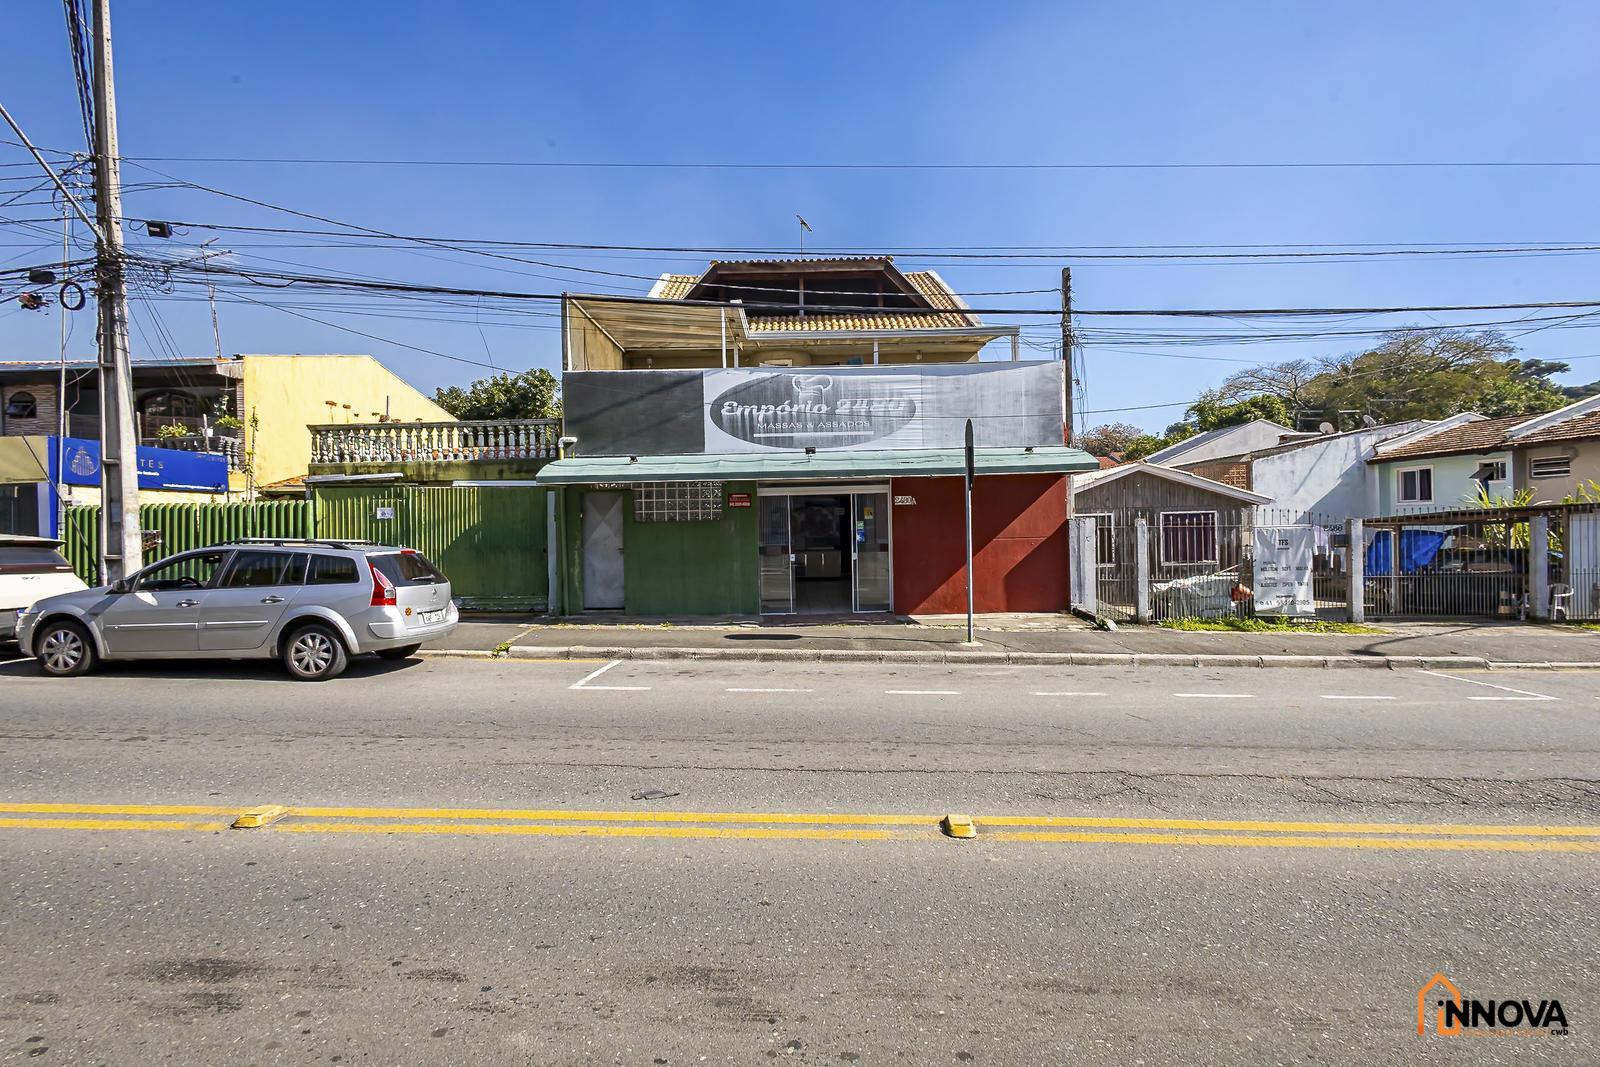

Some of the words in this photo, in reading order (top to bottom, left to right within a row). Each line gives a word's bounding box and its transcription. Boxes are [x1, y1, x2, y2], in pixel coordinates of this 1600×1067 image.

[721, 400, 831, 422] Empório
[757, 421, 803, 430] MASSAS
[807, 421, 815, 429] &
[818, 420, 870, 429] ASSADOS
